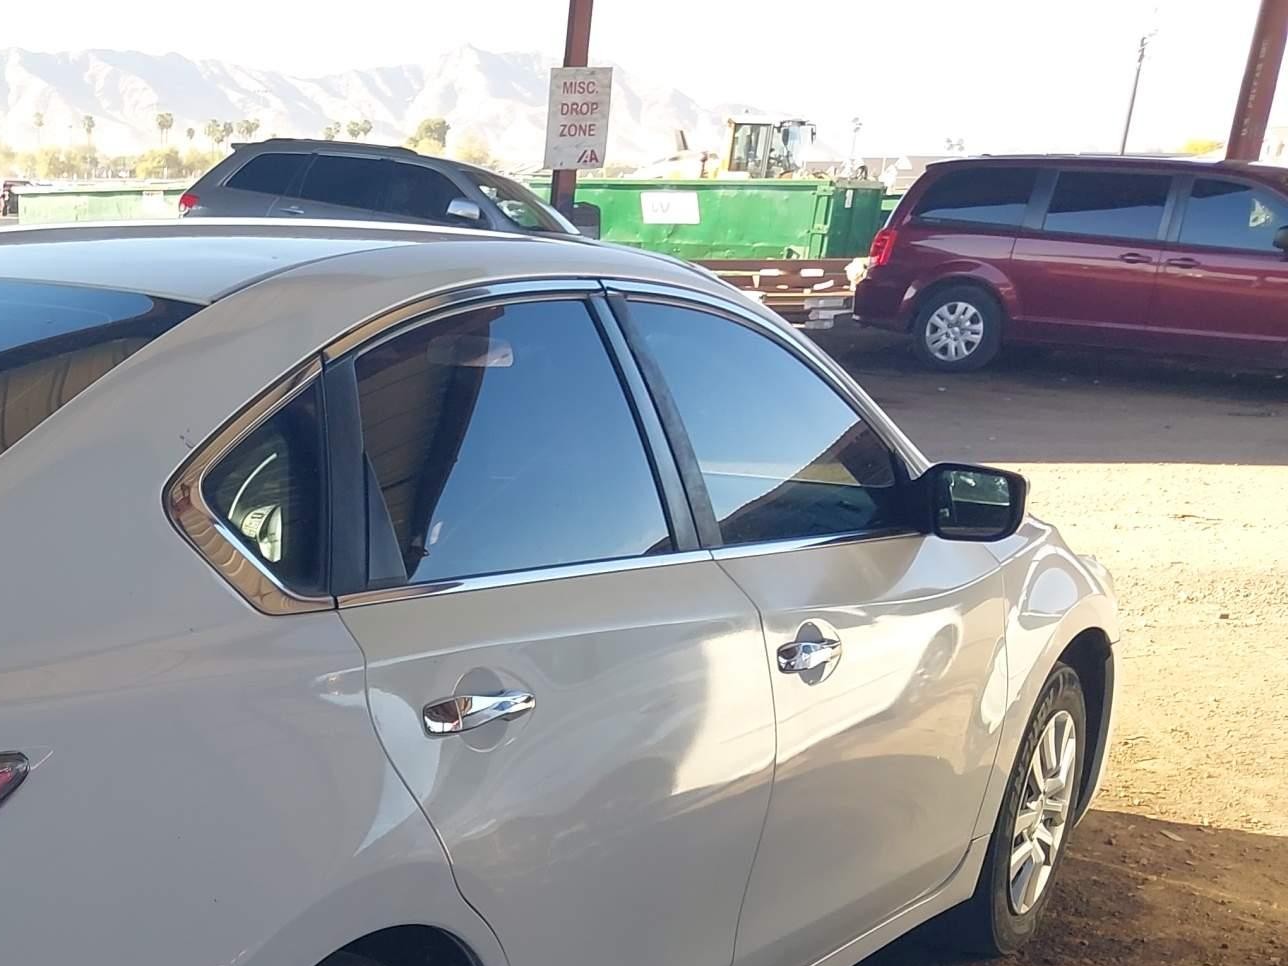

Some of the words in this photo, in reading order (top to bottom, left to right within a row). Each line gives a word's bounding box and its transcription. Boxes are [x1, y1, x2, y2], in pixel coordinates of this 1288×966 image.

[562, 81, 599, 94] MISC.
[560, 102, 599, 116] DROP
[559, 124, 597, 137] ZONE
